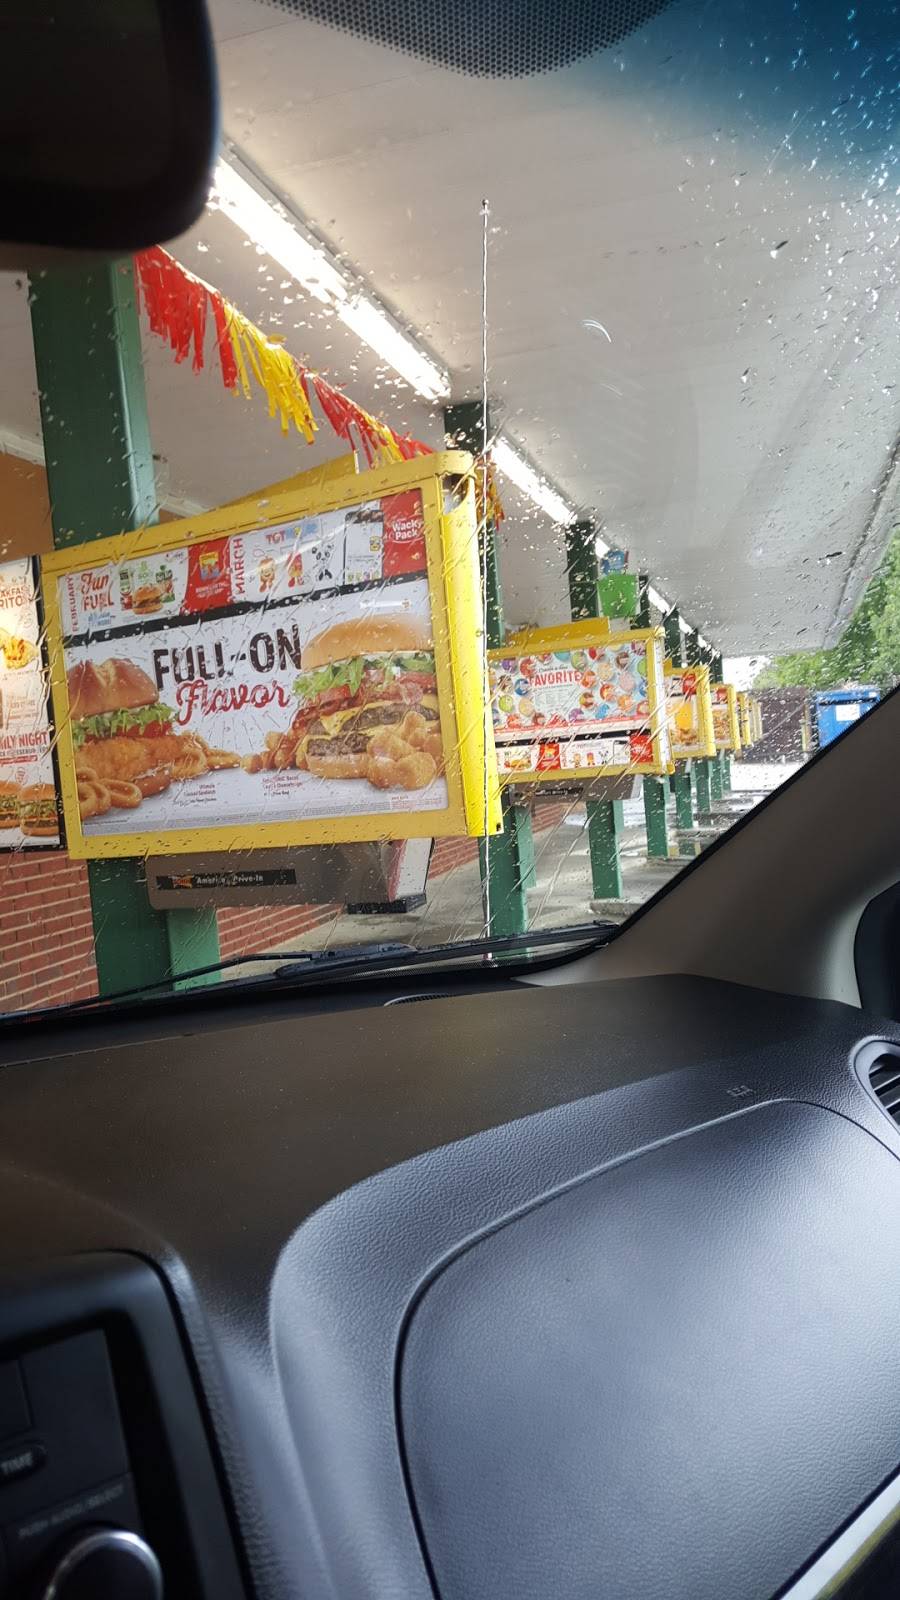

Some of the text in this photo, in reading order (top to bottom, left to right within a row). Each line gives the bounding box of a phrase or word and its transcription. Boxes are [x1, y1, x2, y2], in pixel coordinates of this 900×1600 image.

[392, 519, 423, 532] Wacky
[395, 529, 418, 540] Pack
[234, 538, 246, 595] MARCH
[81, 571, 109, 595] Fun
[153, 623, 301, 689] FULL-ON
[176, 677, 290, 726] Flavor
[18, 731, 48, 748] NIGHT
